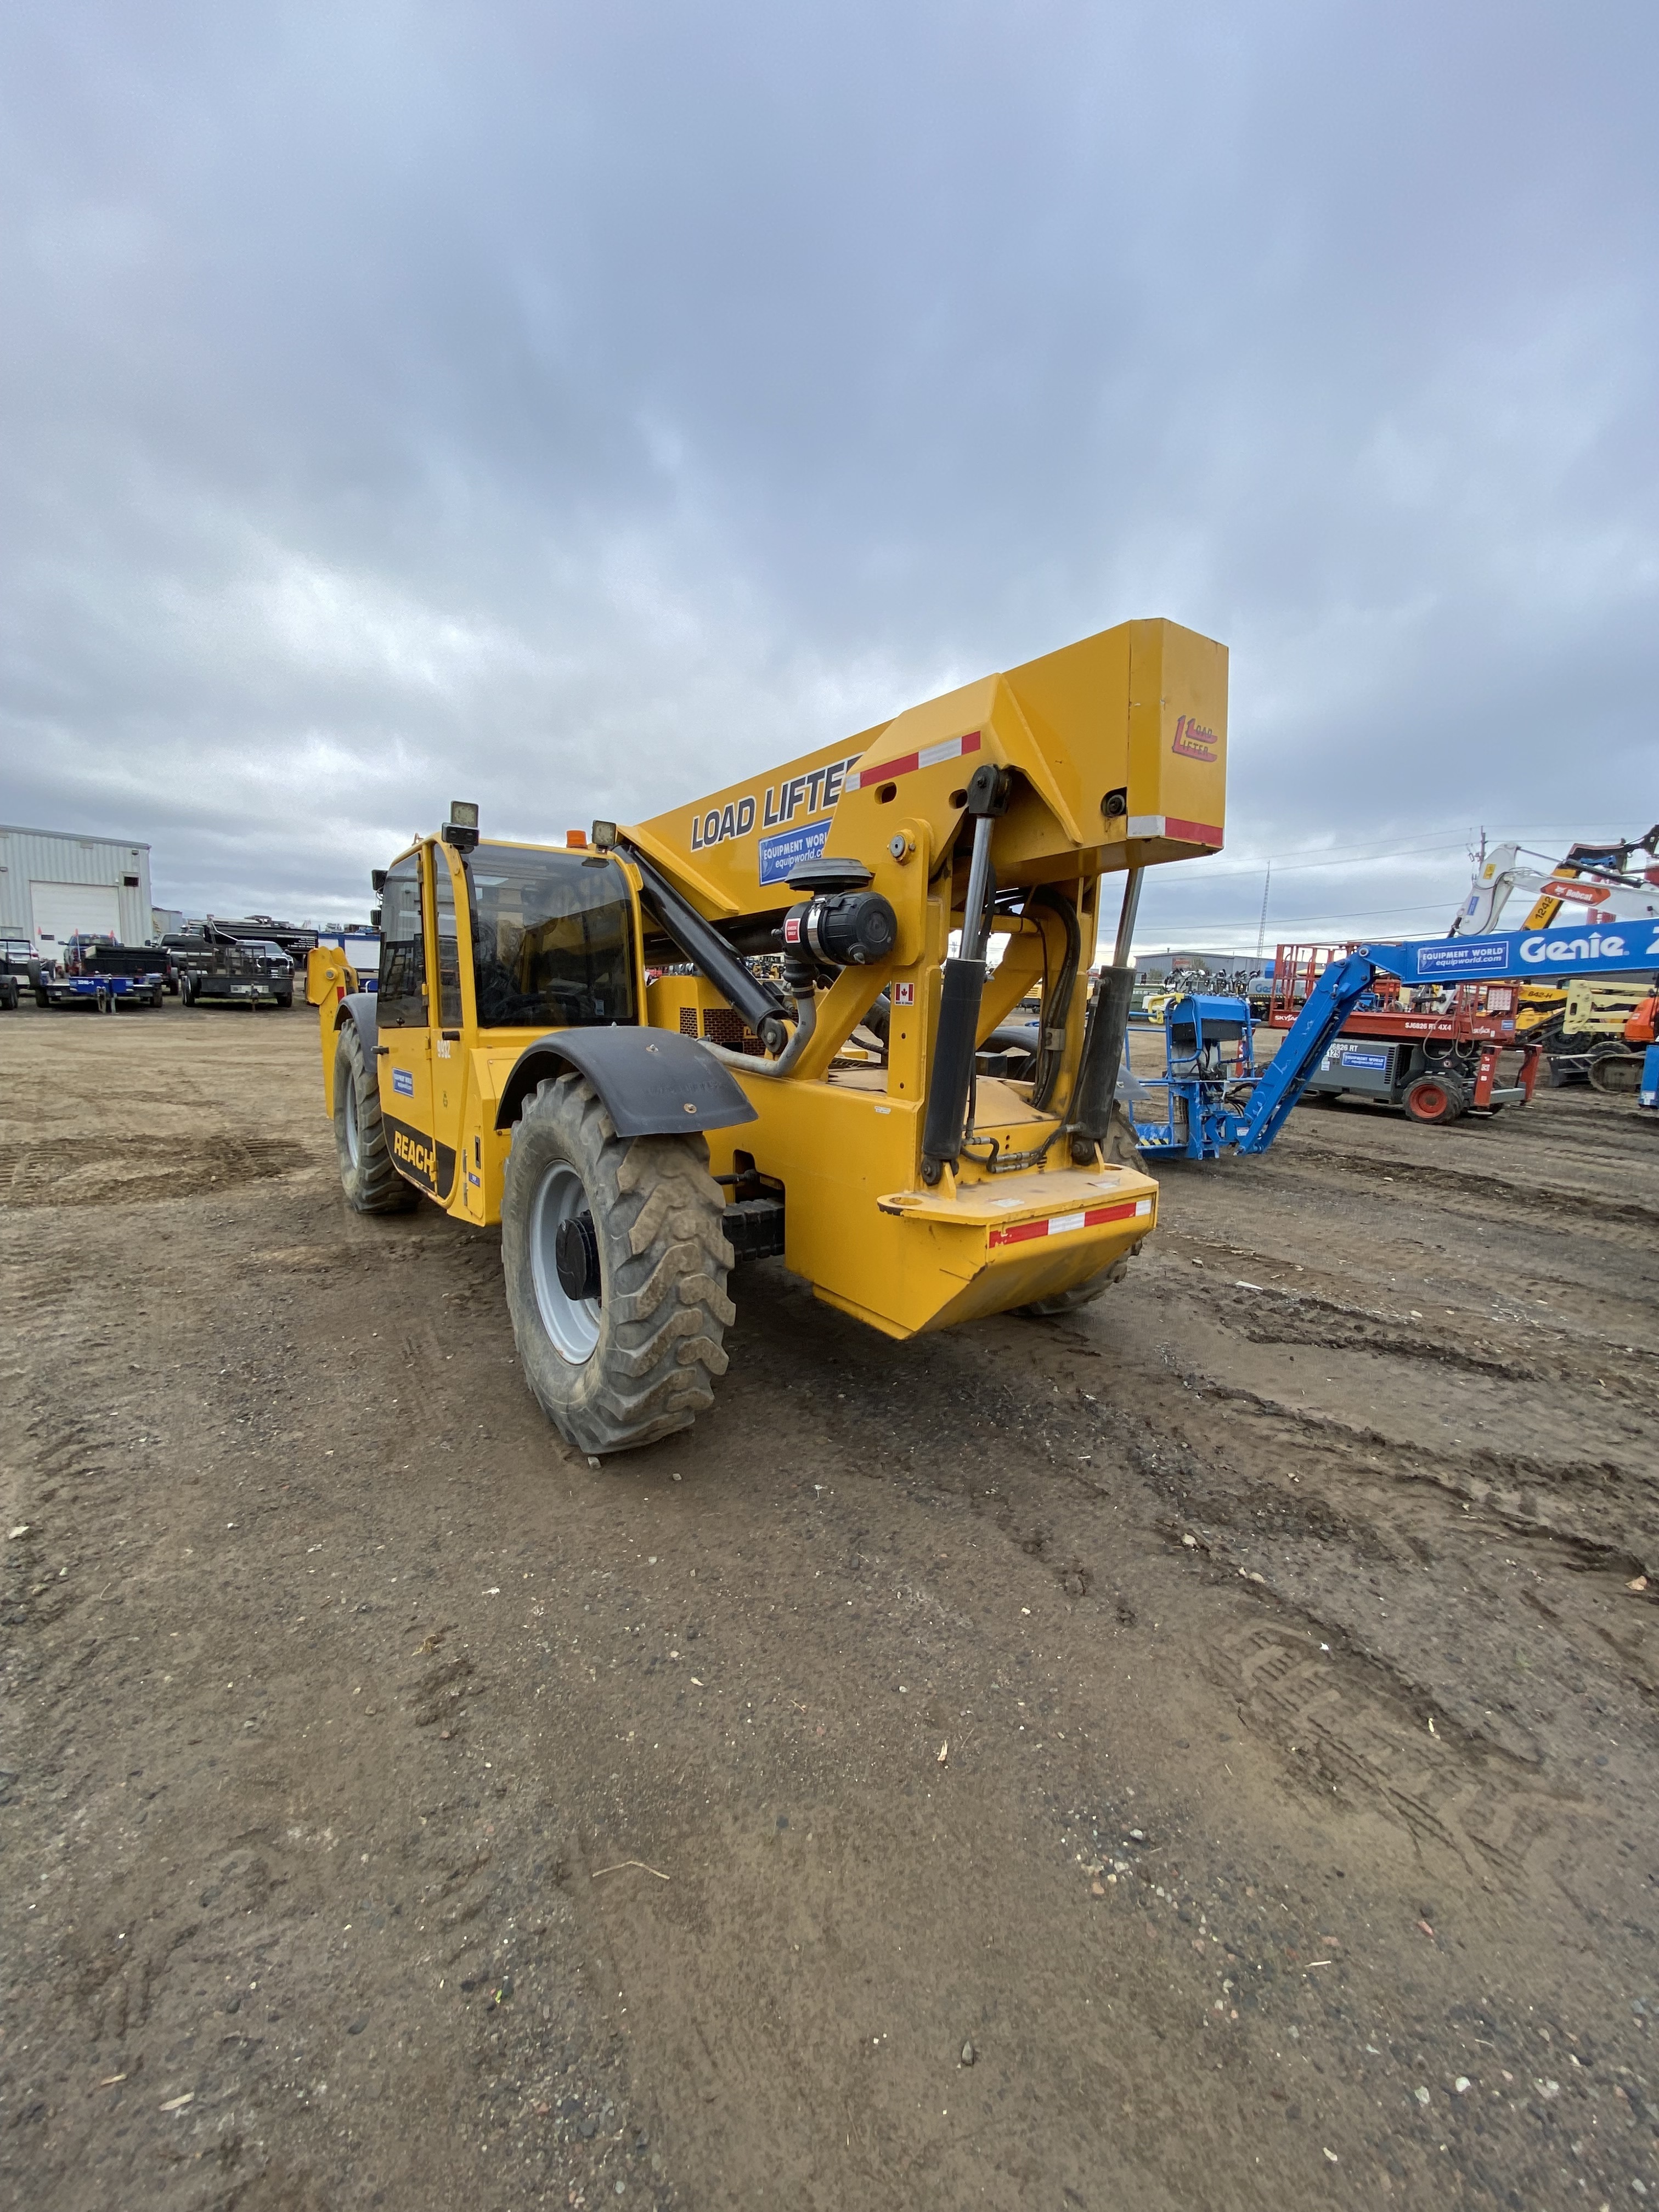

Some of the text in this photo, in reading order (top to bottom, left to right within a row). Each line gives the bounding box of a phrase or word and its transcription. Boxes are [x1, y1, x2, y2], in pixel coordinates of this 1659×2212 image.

[691, 795, 757, 853] LOAD
[764, 839, 803, 860] EQUIPMENT
[1565, 889, 1593, 901] Bobcat
[1536, 896, 1554, 919] 1242
[1423, 947, 1503, 960] EQUIPMENT WORLD
[1520, 932, 1626, 963] Genie
[1436, 956, 1502, 967] equipworld.com
